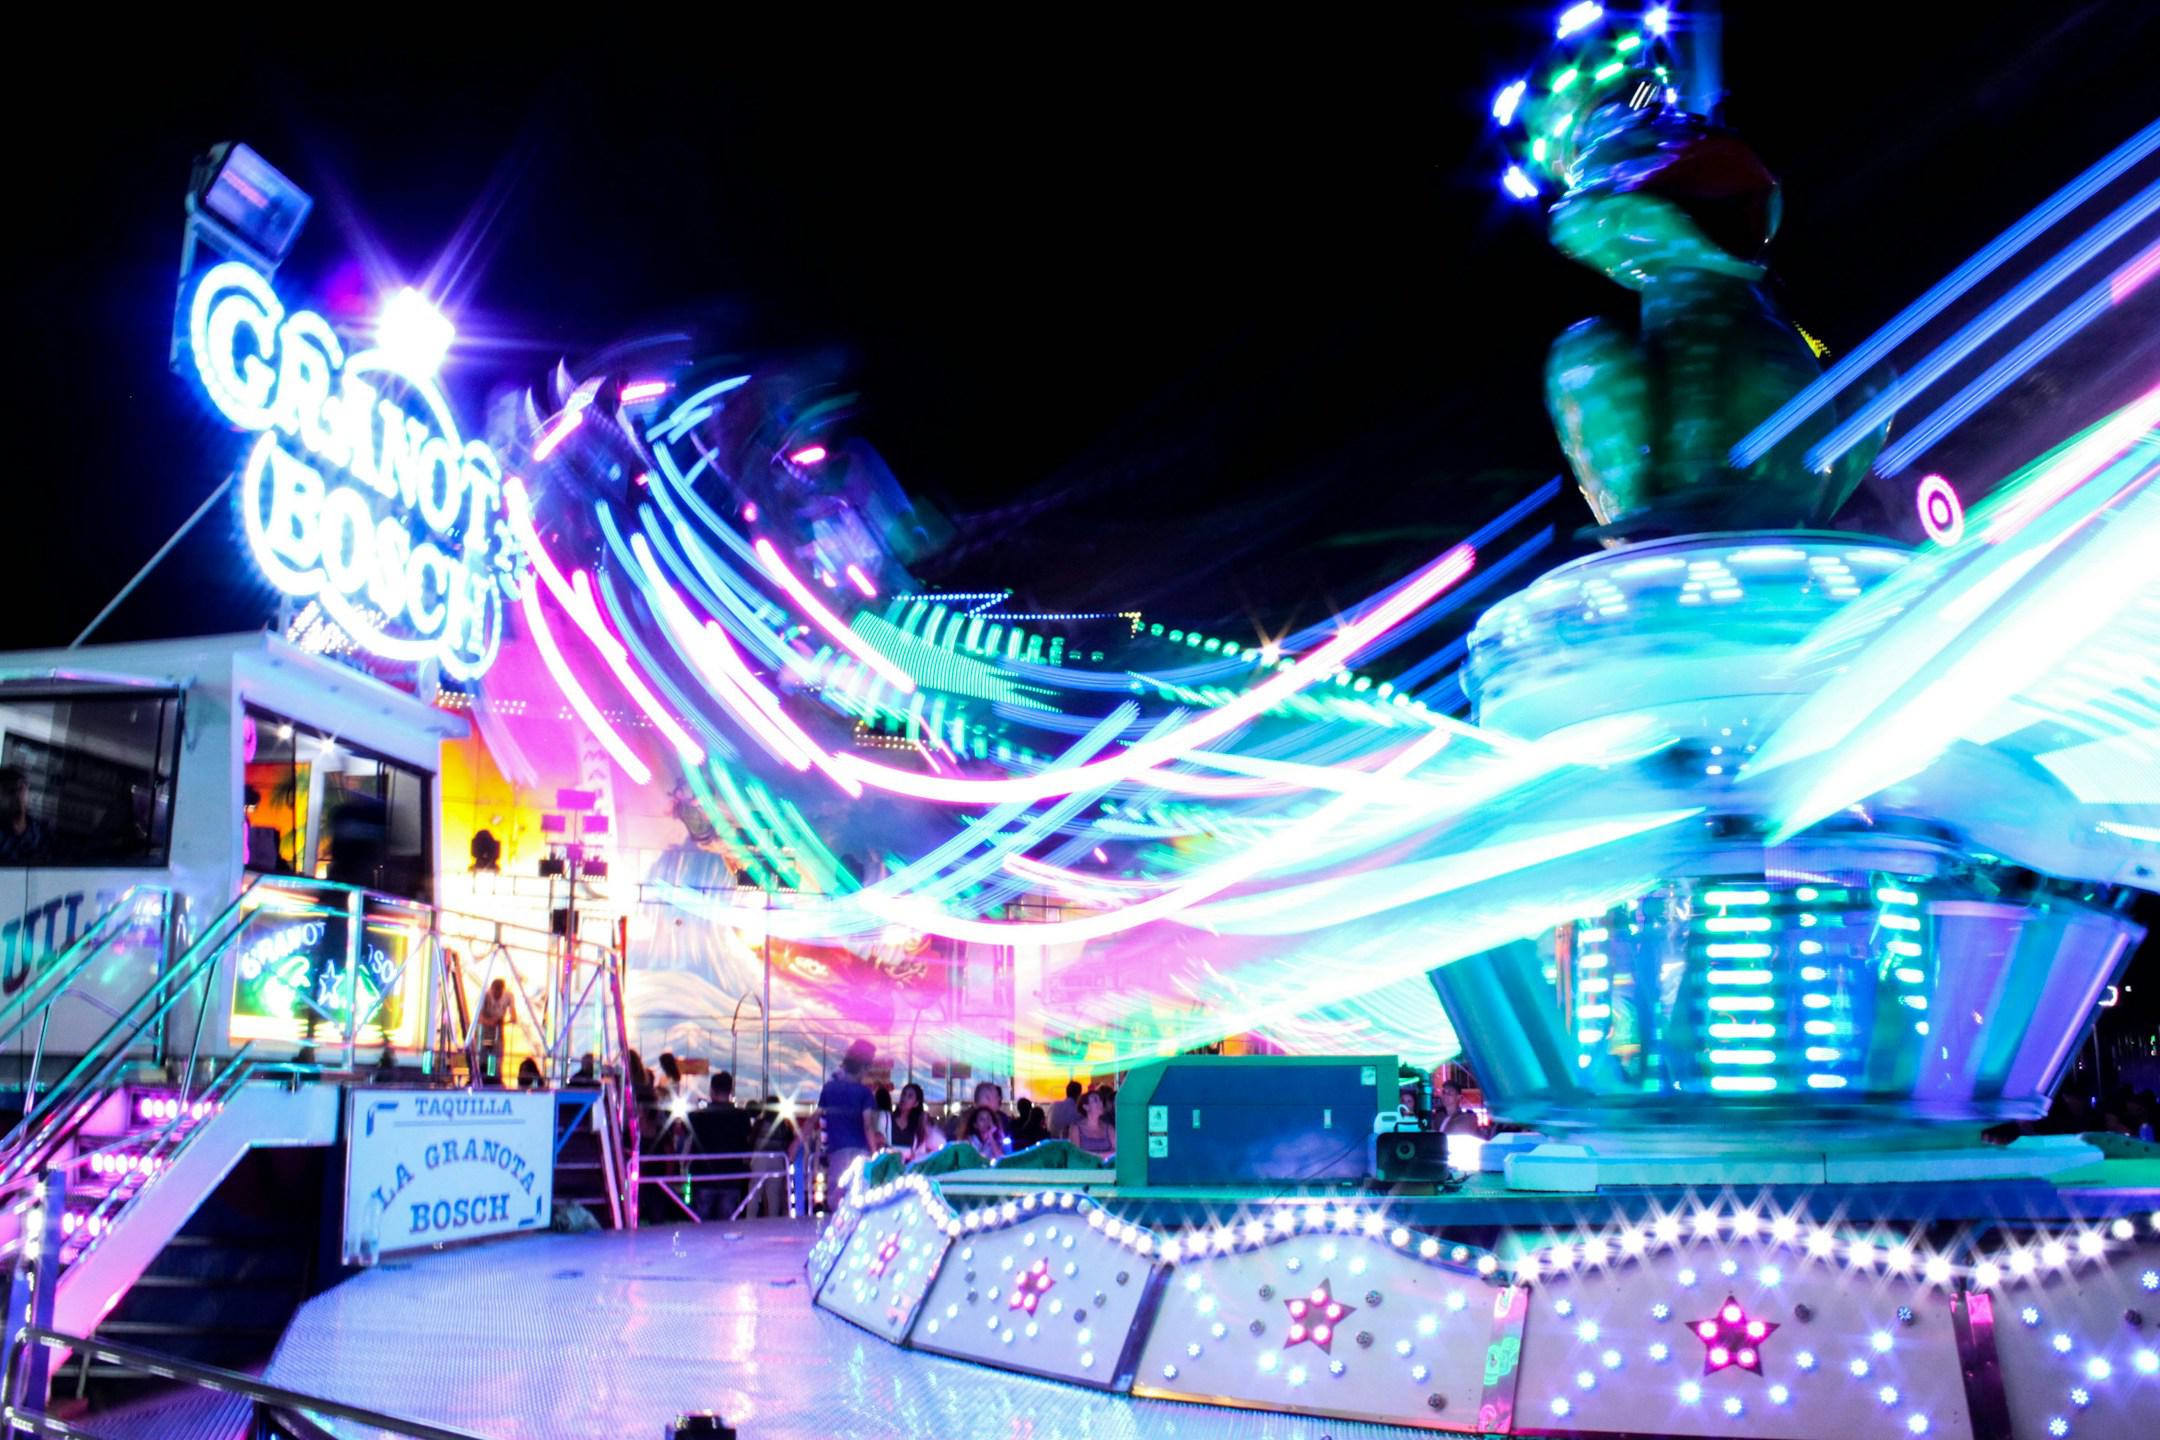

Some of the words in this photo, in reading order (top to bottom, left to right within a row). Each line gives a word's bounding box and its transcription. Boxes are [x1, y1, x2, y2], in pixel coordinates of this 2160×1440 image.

[246, 434, 502, 678] BOSCH
[415, 1096, 513, 1119] TAQUILLA
[371, 1162, 415, 1211] LA
[424, 1138, 536, 1195] GRANOTA
[409, 1193, 511, 1234] BOSCH
